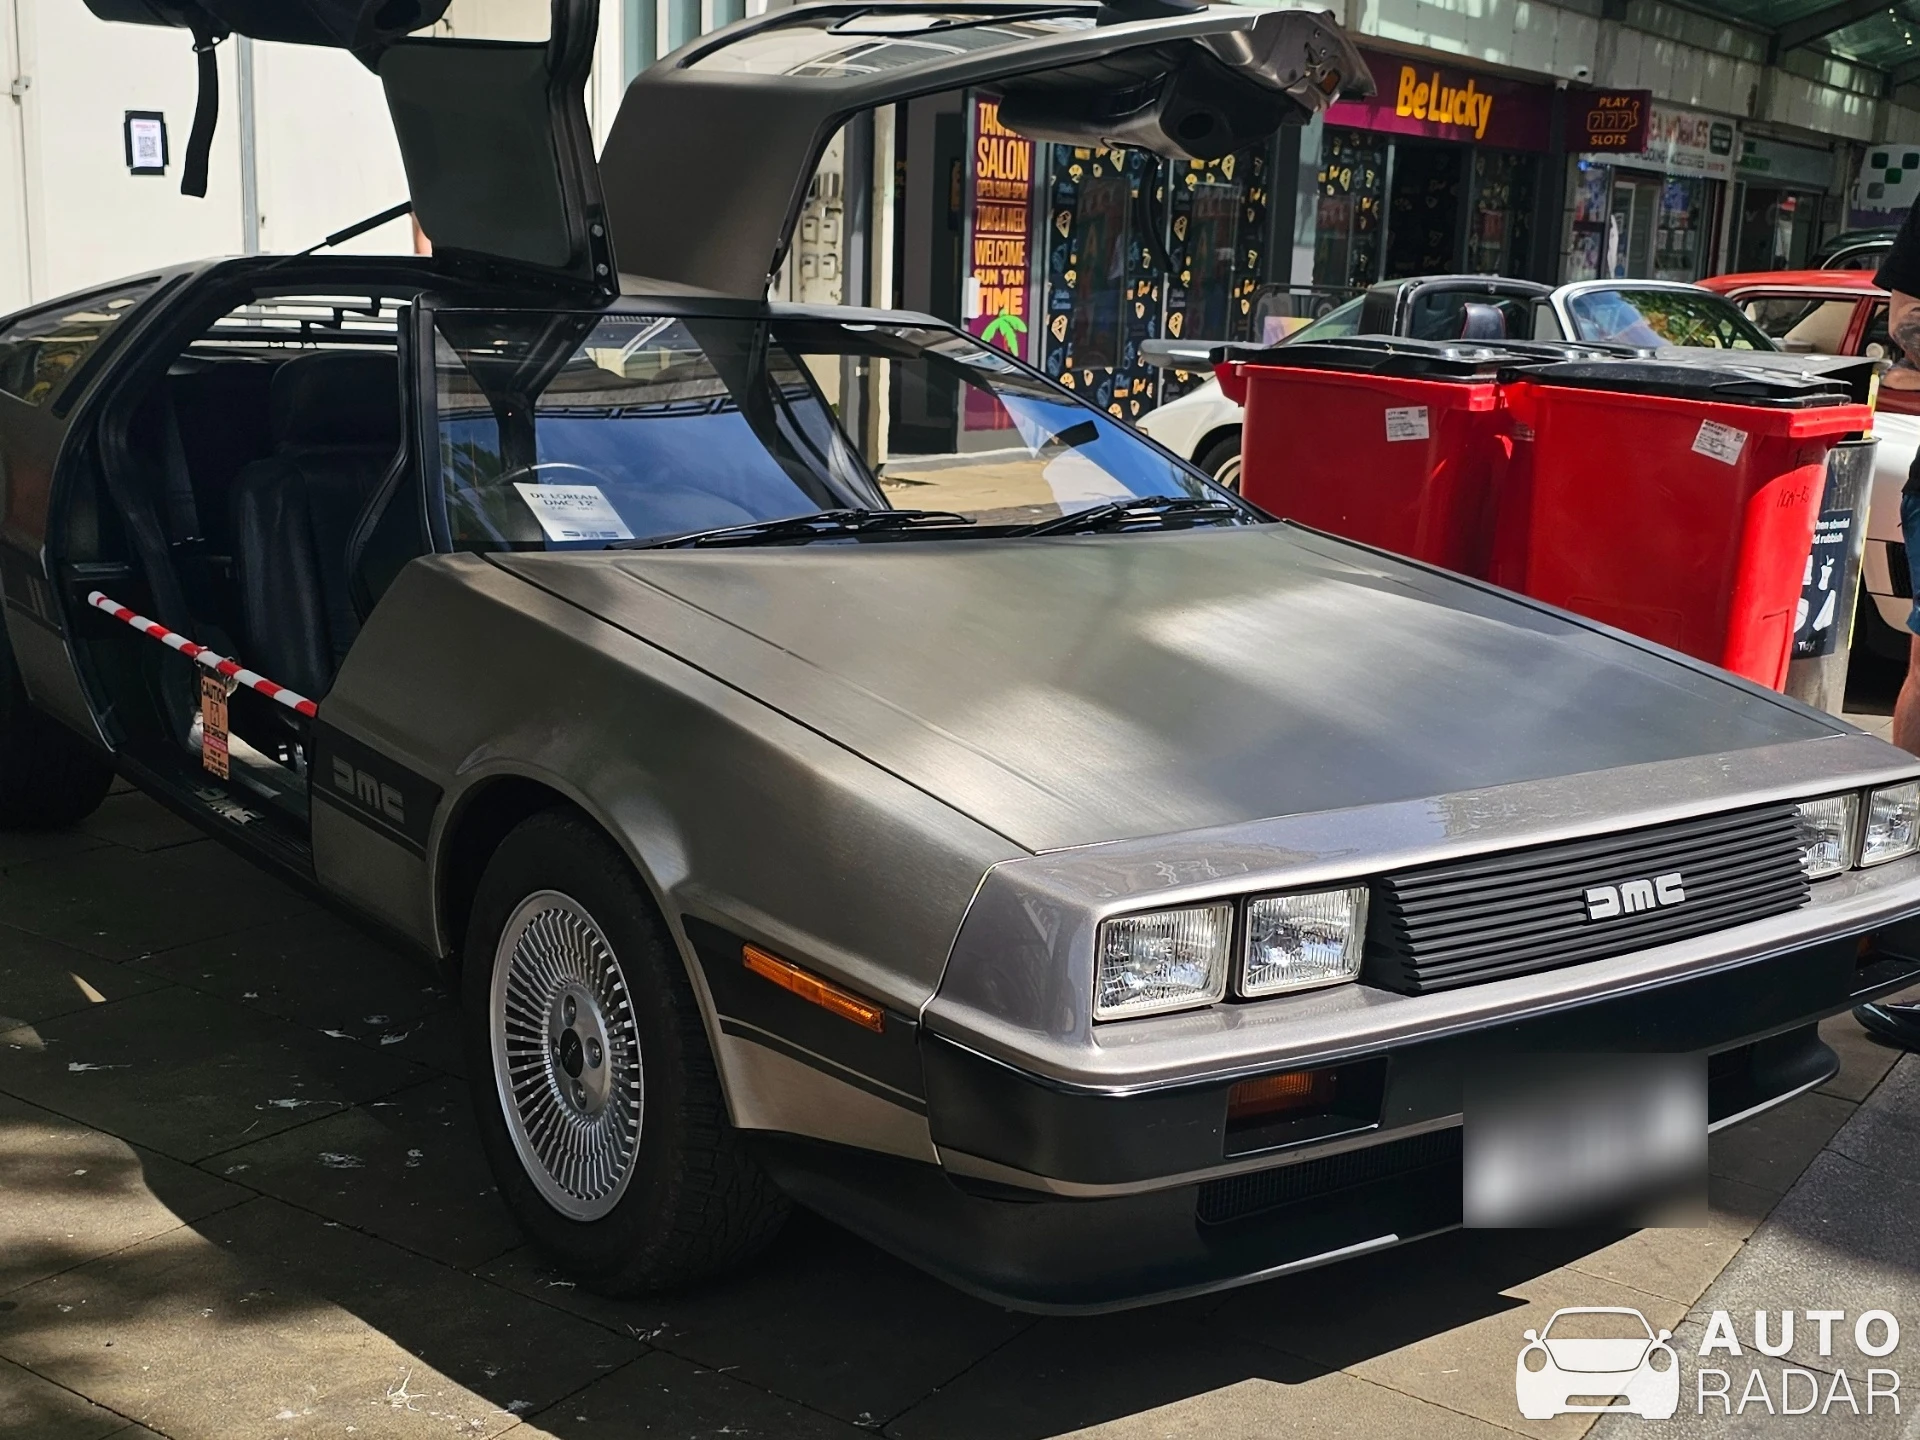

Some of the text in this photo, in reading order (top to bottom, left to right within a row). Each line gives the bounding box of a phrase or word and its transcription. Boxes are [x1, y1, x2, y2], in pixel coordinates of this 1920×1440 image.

[1396, 66, 1493, 139] BeLucky
[1599, 96, 1630, 108] PLAY
[1592, 114, 1628, 128] 777
[1590, 134, 1627, 145] SLOTS
[977, 136, 1030, 181] SALON
[974, 239, 1025, 267] WELCOME
[974, 268, 1025, 285] SUN TAN
[979, 287, 1023, 315] TIME
[1820, 532, 1843, 543] rubbish
